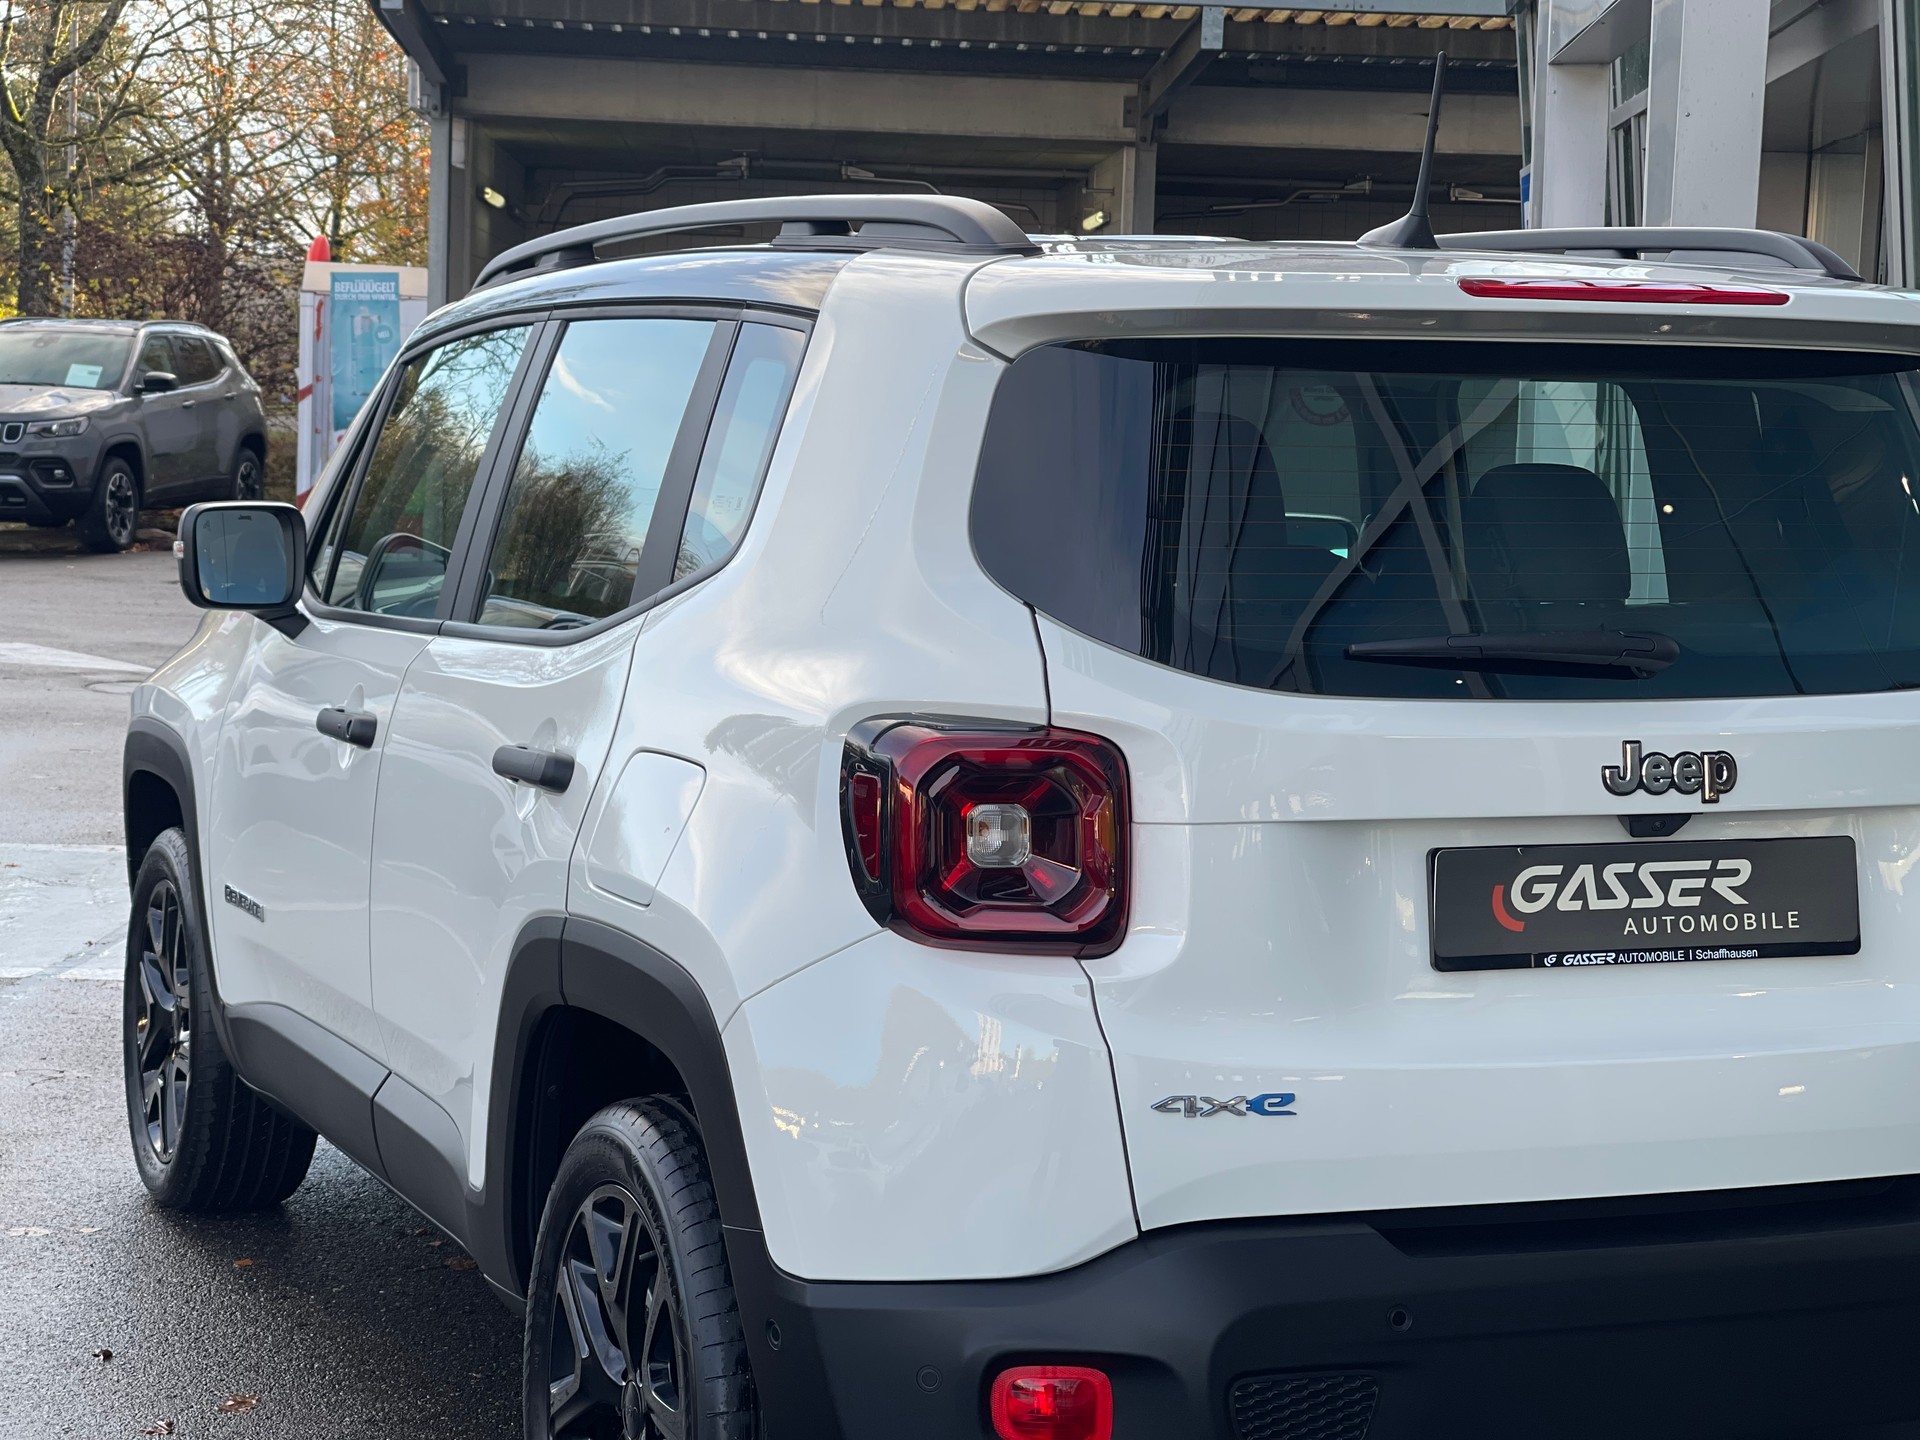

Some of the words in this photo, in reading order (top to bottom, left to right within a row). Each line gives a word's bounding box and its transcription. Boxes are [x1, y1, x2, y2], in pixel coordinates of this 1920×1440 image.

[334, 279, 396, 293] BEFLÜÜÜGELT
[1601, 740, 1738, 804] Jeep
[1510, 858, 1752, 914] GASSER
[1623, 911, 1801, 935] AUTOMOBILE
[1562, 952, 1616, 966] GASSER
[1617, 949, 1685, 964] AUTOMOBILE
[1695, 948, 1758, 960] Schaffhausen
